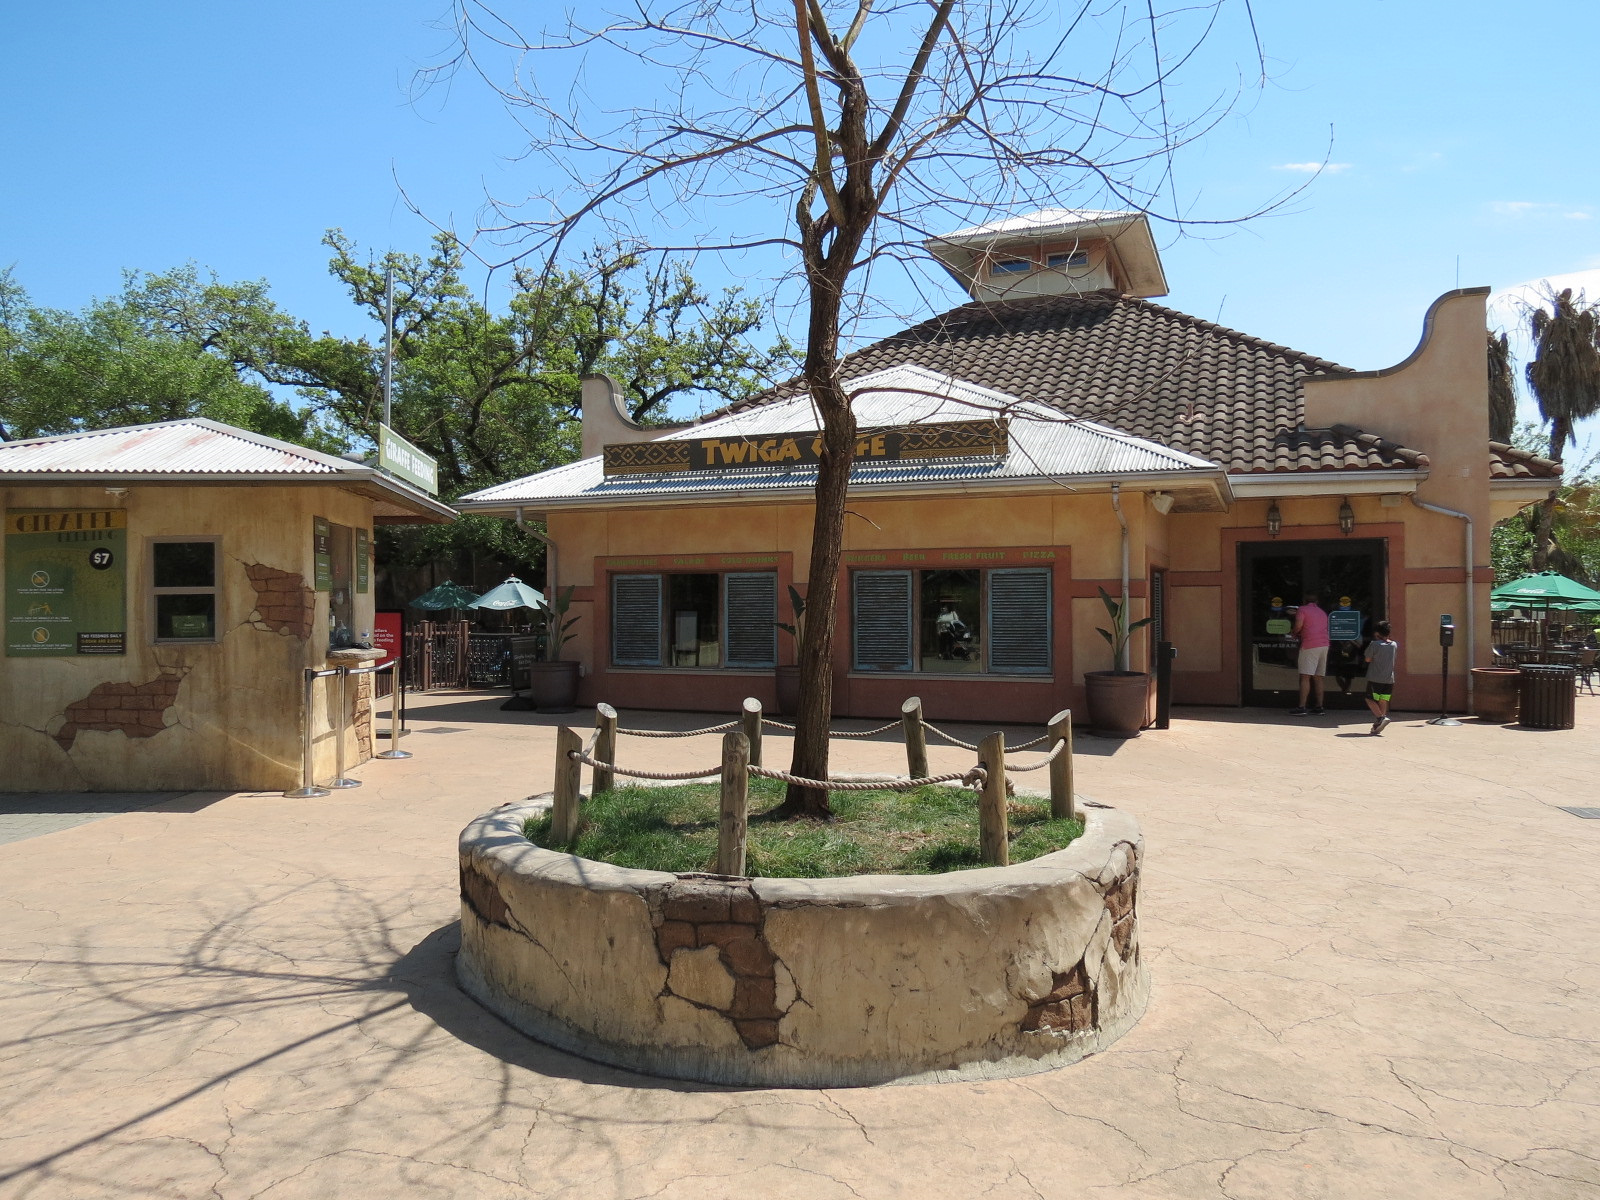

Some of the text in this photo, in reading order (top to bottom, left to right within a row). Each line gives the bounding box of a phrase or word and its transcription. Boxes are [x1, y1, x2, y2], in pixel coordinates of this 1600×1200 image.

[701, 433, 886, 464] TWIGA CFE
[94, 552, 110, 565] $7
[976, 551, 1006, 559] FRUIT
[1022, 550, 1056, 559] PIZZA
